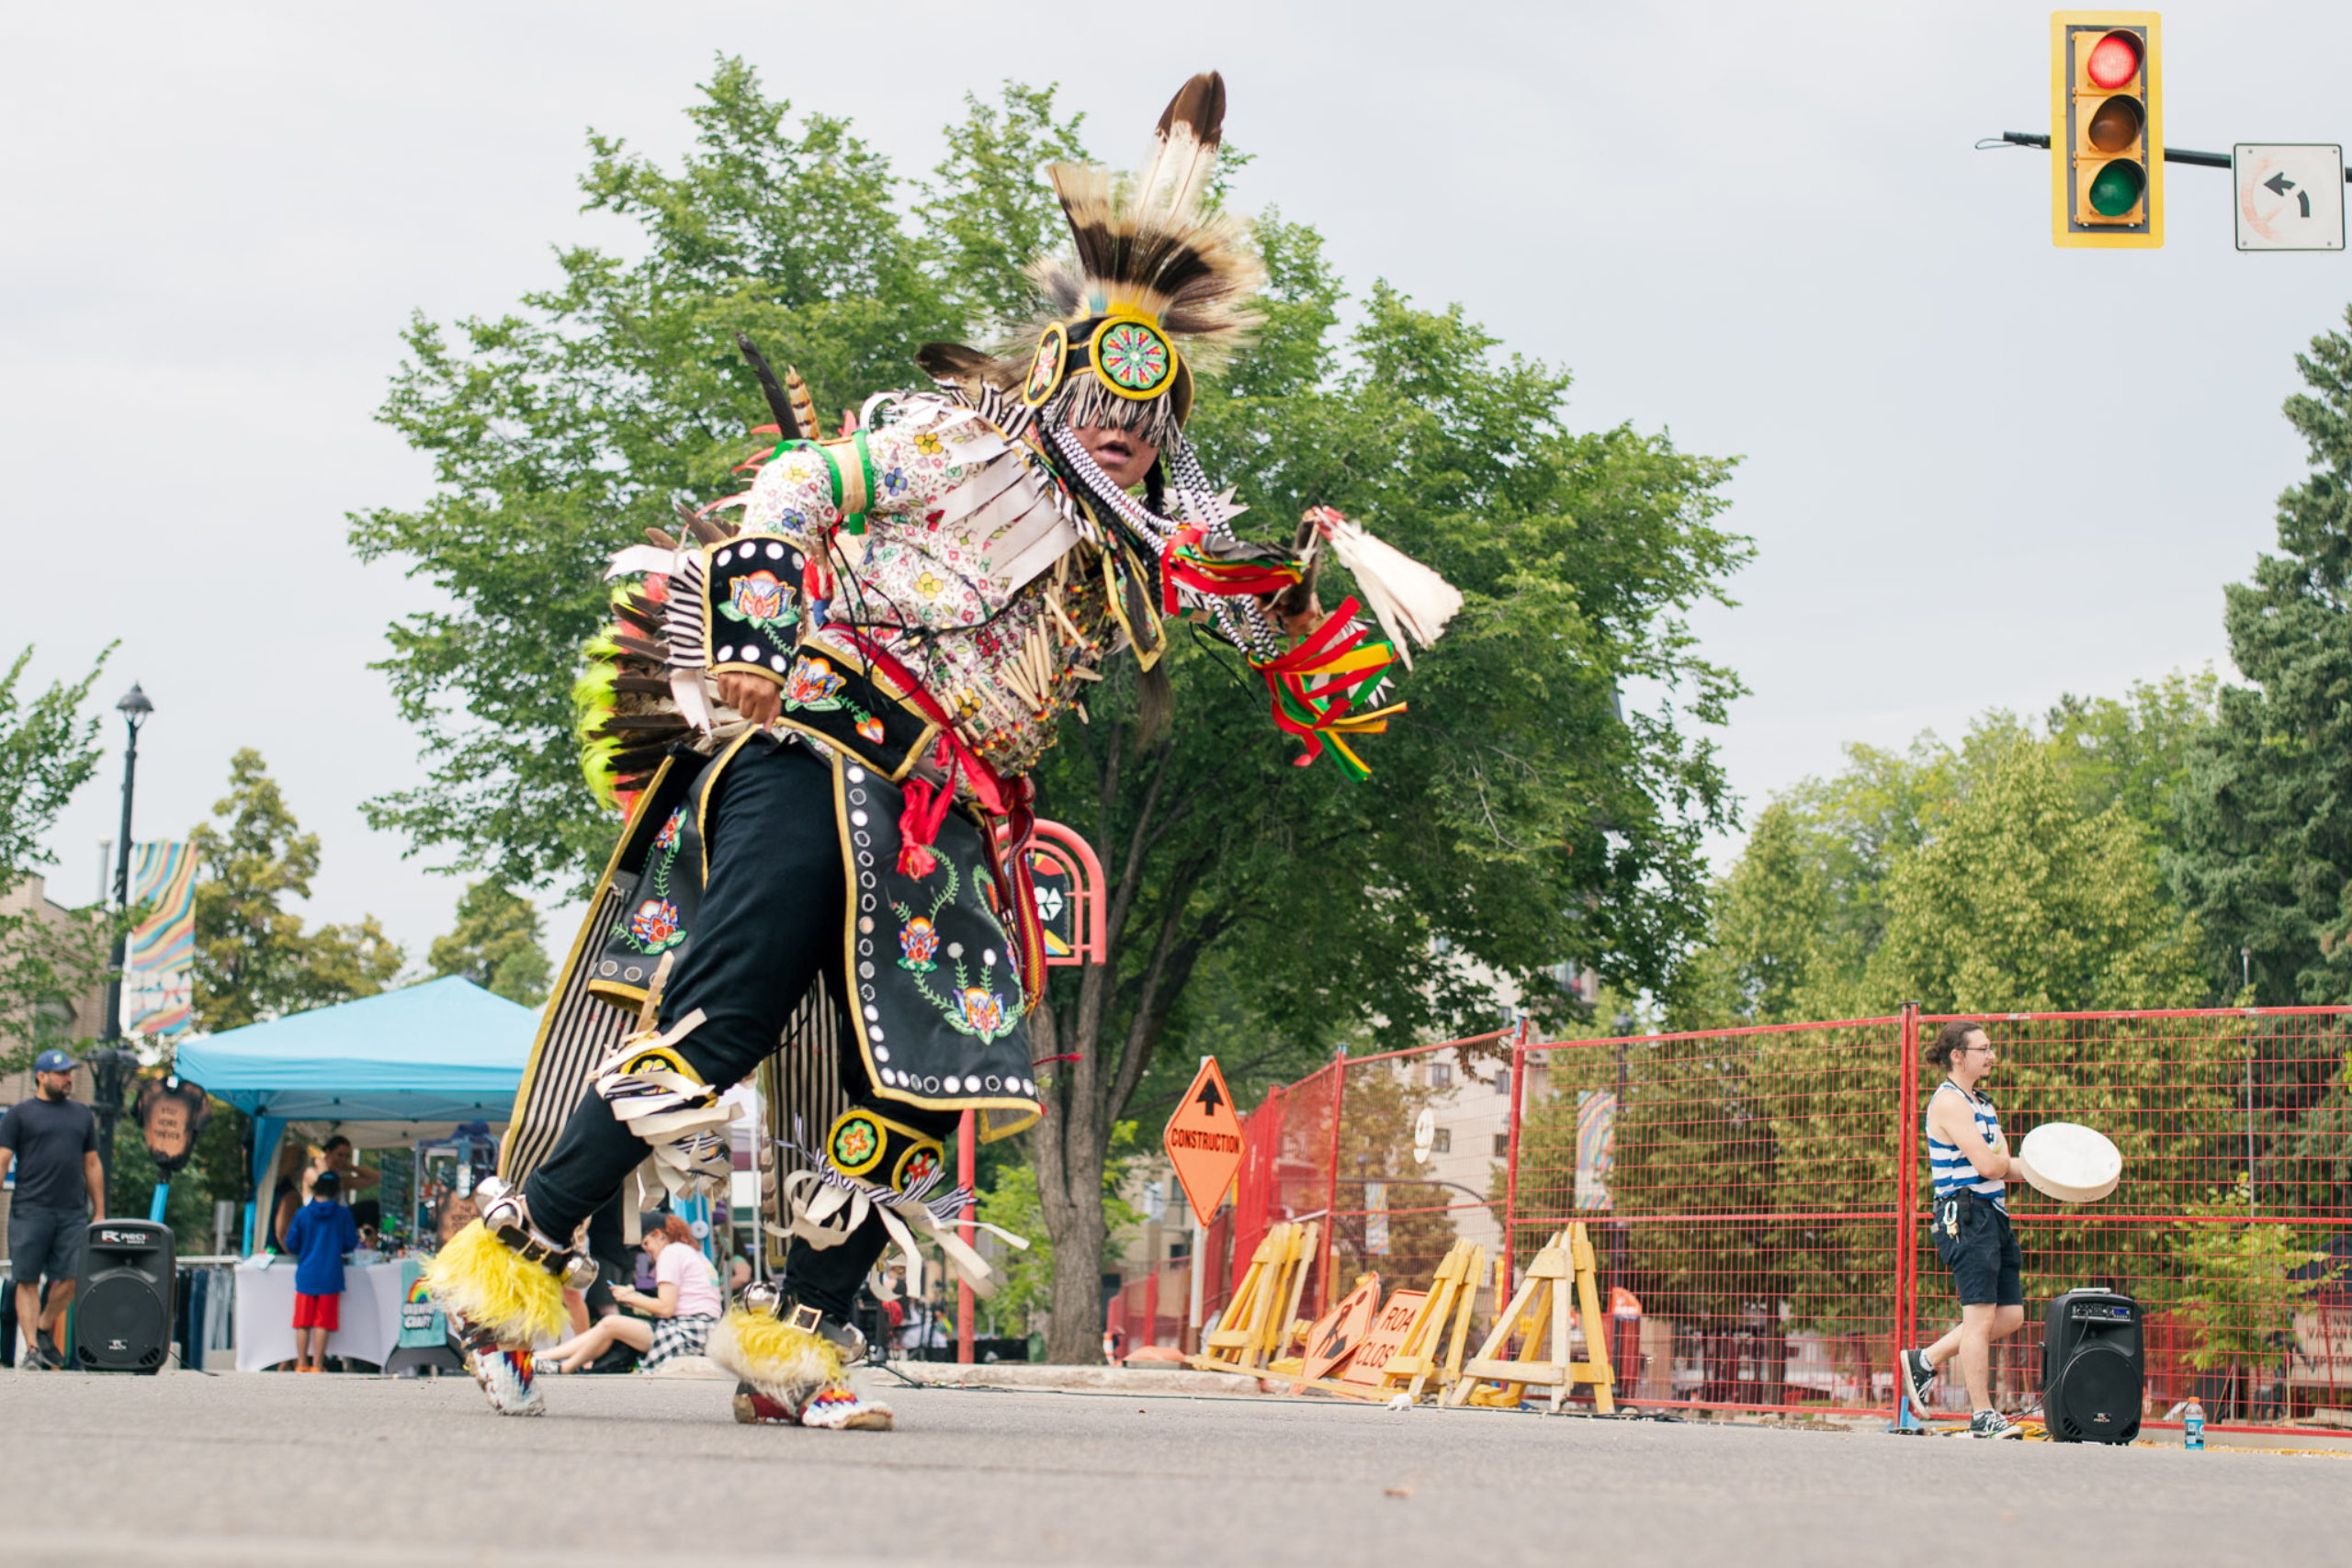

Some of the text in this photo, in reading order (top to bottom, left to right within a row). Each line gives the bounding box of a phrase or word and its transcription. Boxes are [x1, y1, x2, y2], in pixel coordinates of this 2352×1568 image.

[1171, 1128, 1240, 1155] CONSTRUCTION
[1380, 1306, 1417, 1333] ROA
[1355, 1341, 1400, 1369] CLOS
